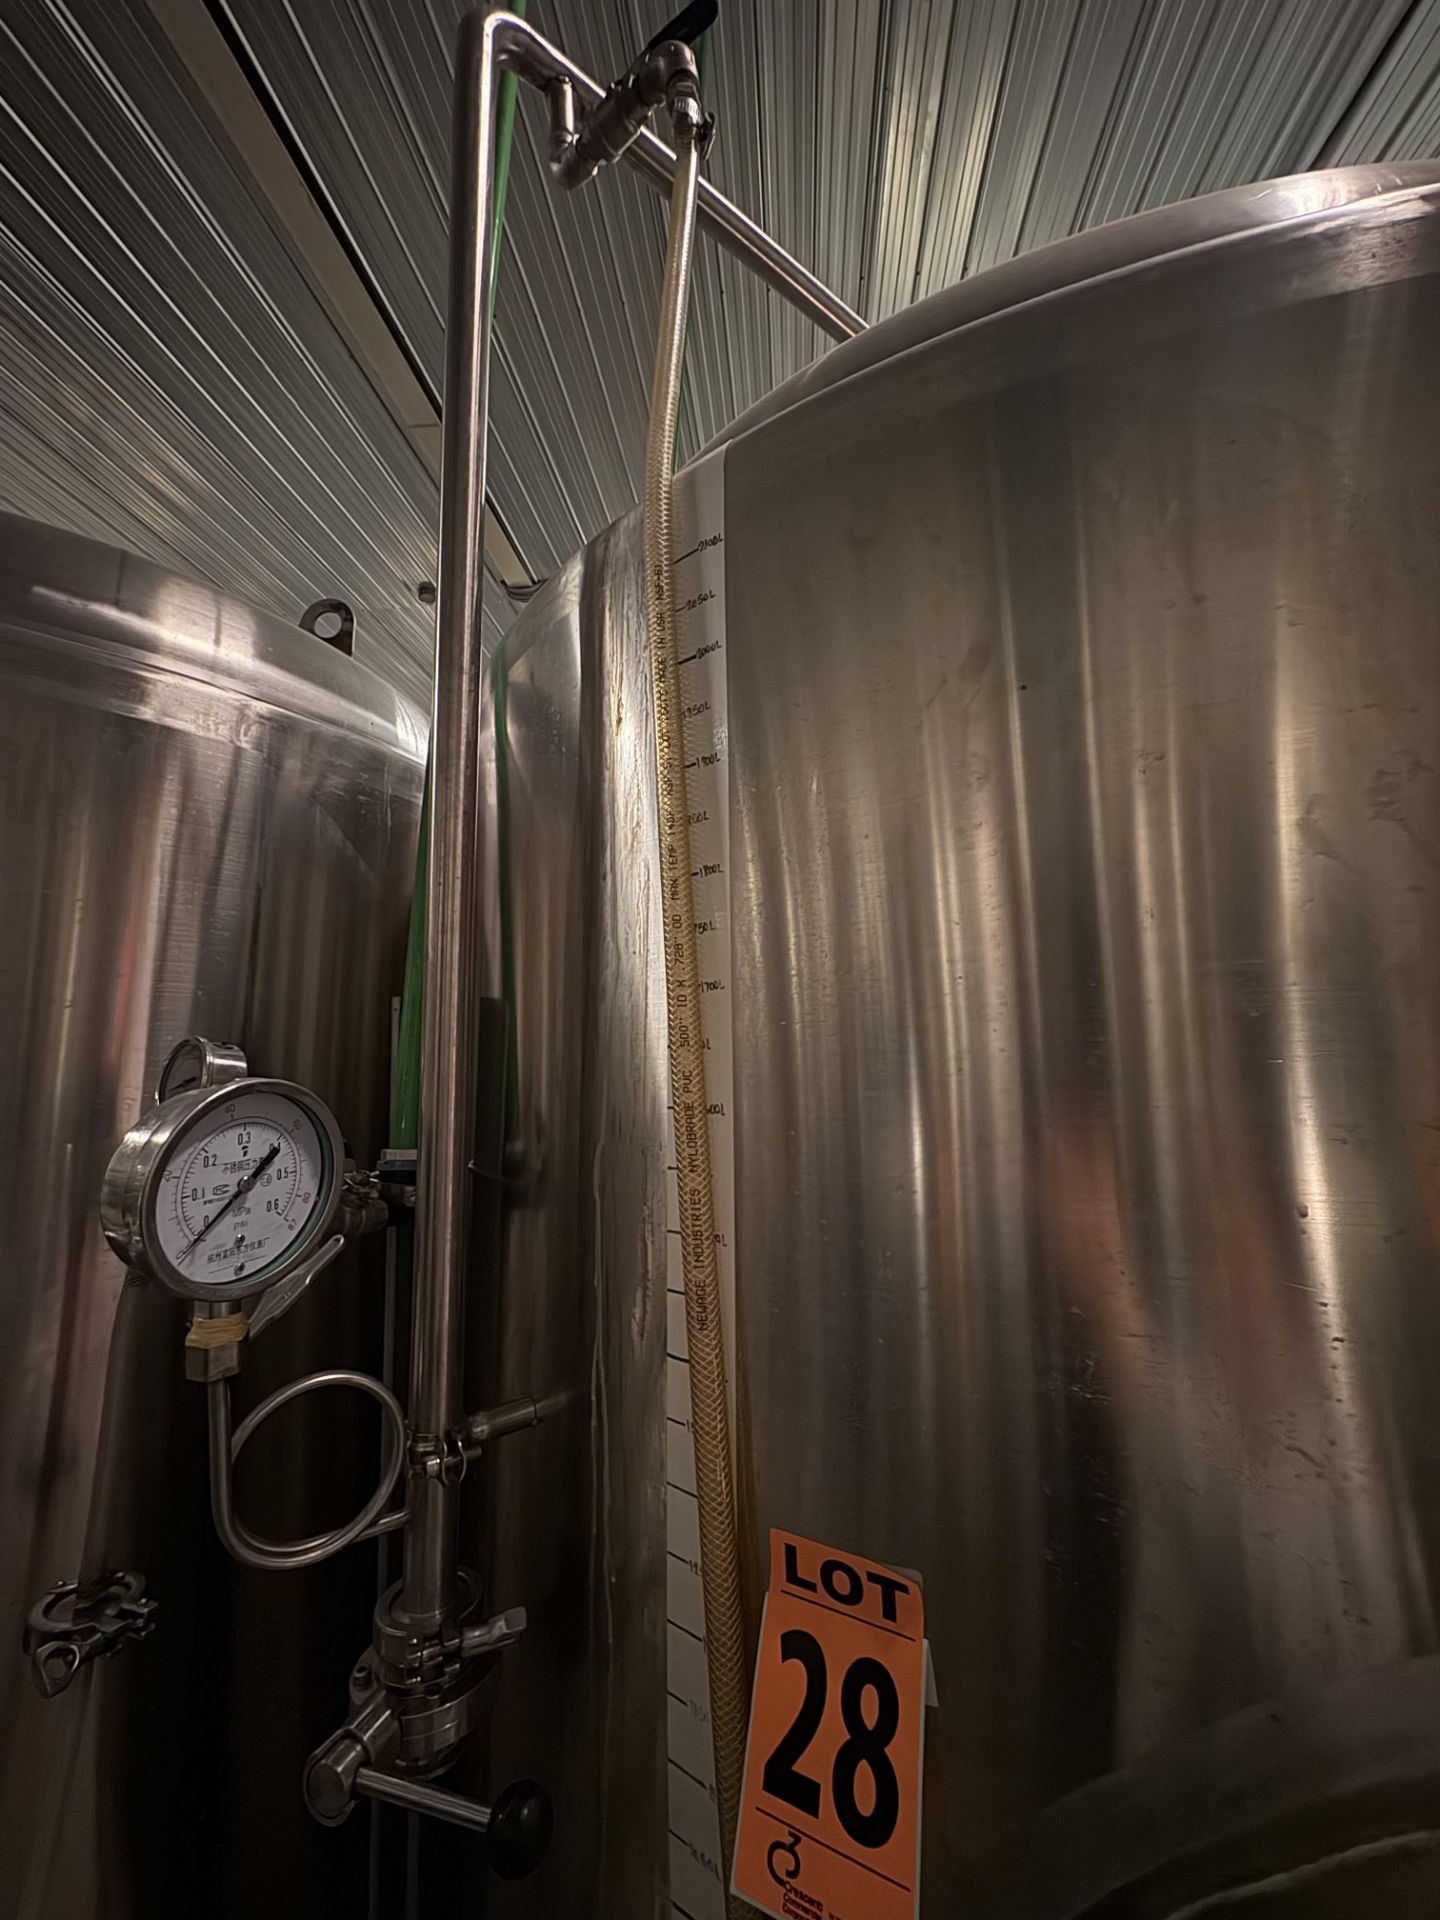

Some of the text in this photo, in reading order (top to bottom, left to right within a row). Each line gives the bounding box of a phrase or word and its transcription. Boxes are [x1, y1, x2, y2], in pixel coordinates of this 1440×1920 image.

[667, 845, 678, 870] TEMP
[669, 878, 680, 901] MAX
[671, 914, 682, 929] OD
[675, 979, 686, 988] X
[682, 1070, 693, 1094] PVC
[237, 1131, 251, 1146] 0.3
[683, 1101, 698, 1174] NYLOBRADE
[203, 1153, 218, 1169] 0.2
[276, 1166, 289, 1181] 0.5
[191, 1187, 205, 1202] 0.1
[266, 1198, 280, 1213] 0.6
[689, 1188, 706, 1269] INDUSTRIES
[694, 1279, 708, 1331] NEWAGE
[784, 1542, 910, 1623] LOT
[762, 1629, 899, 1849] 28
